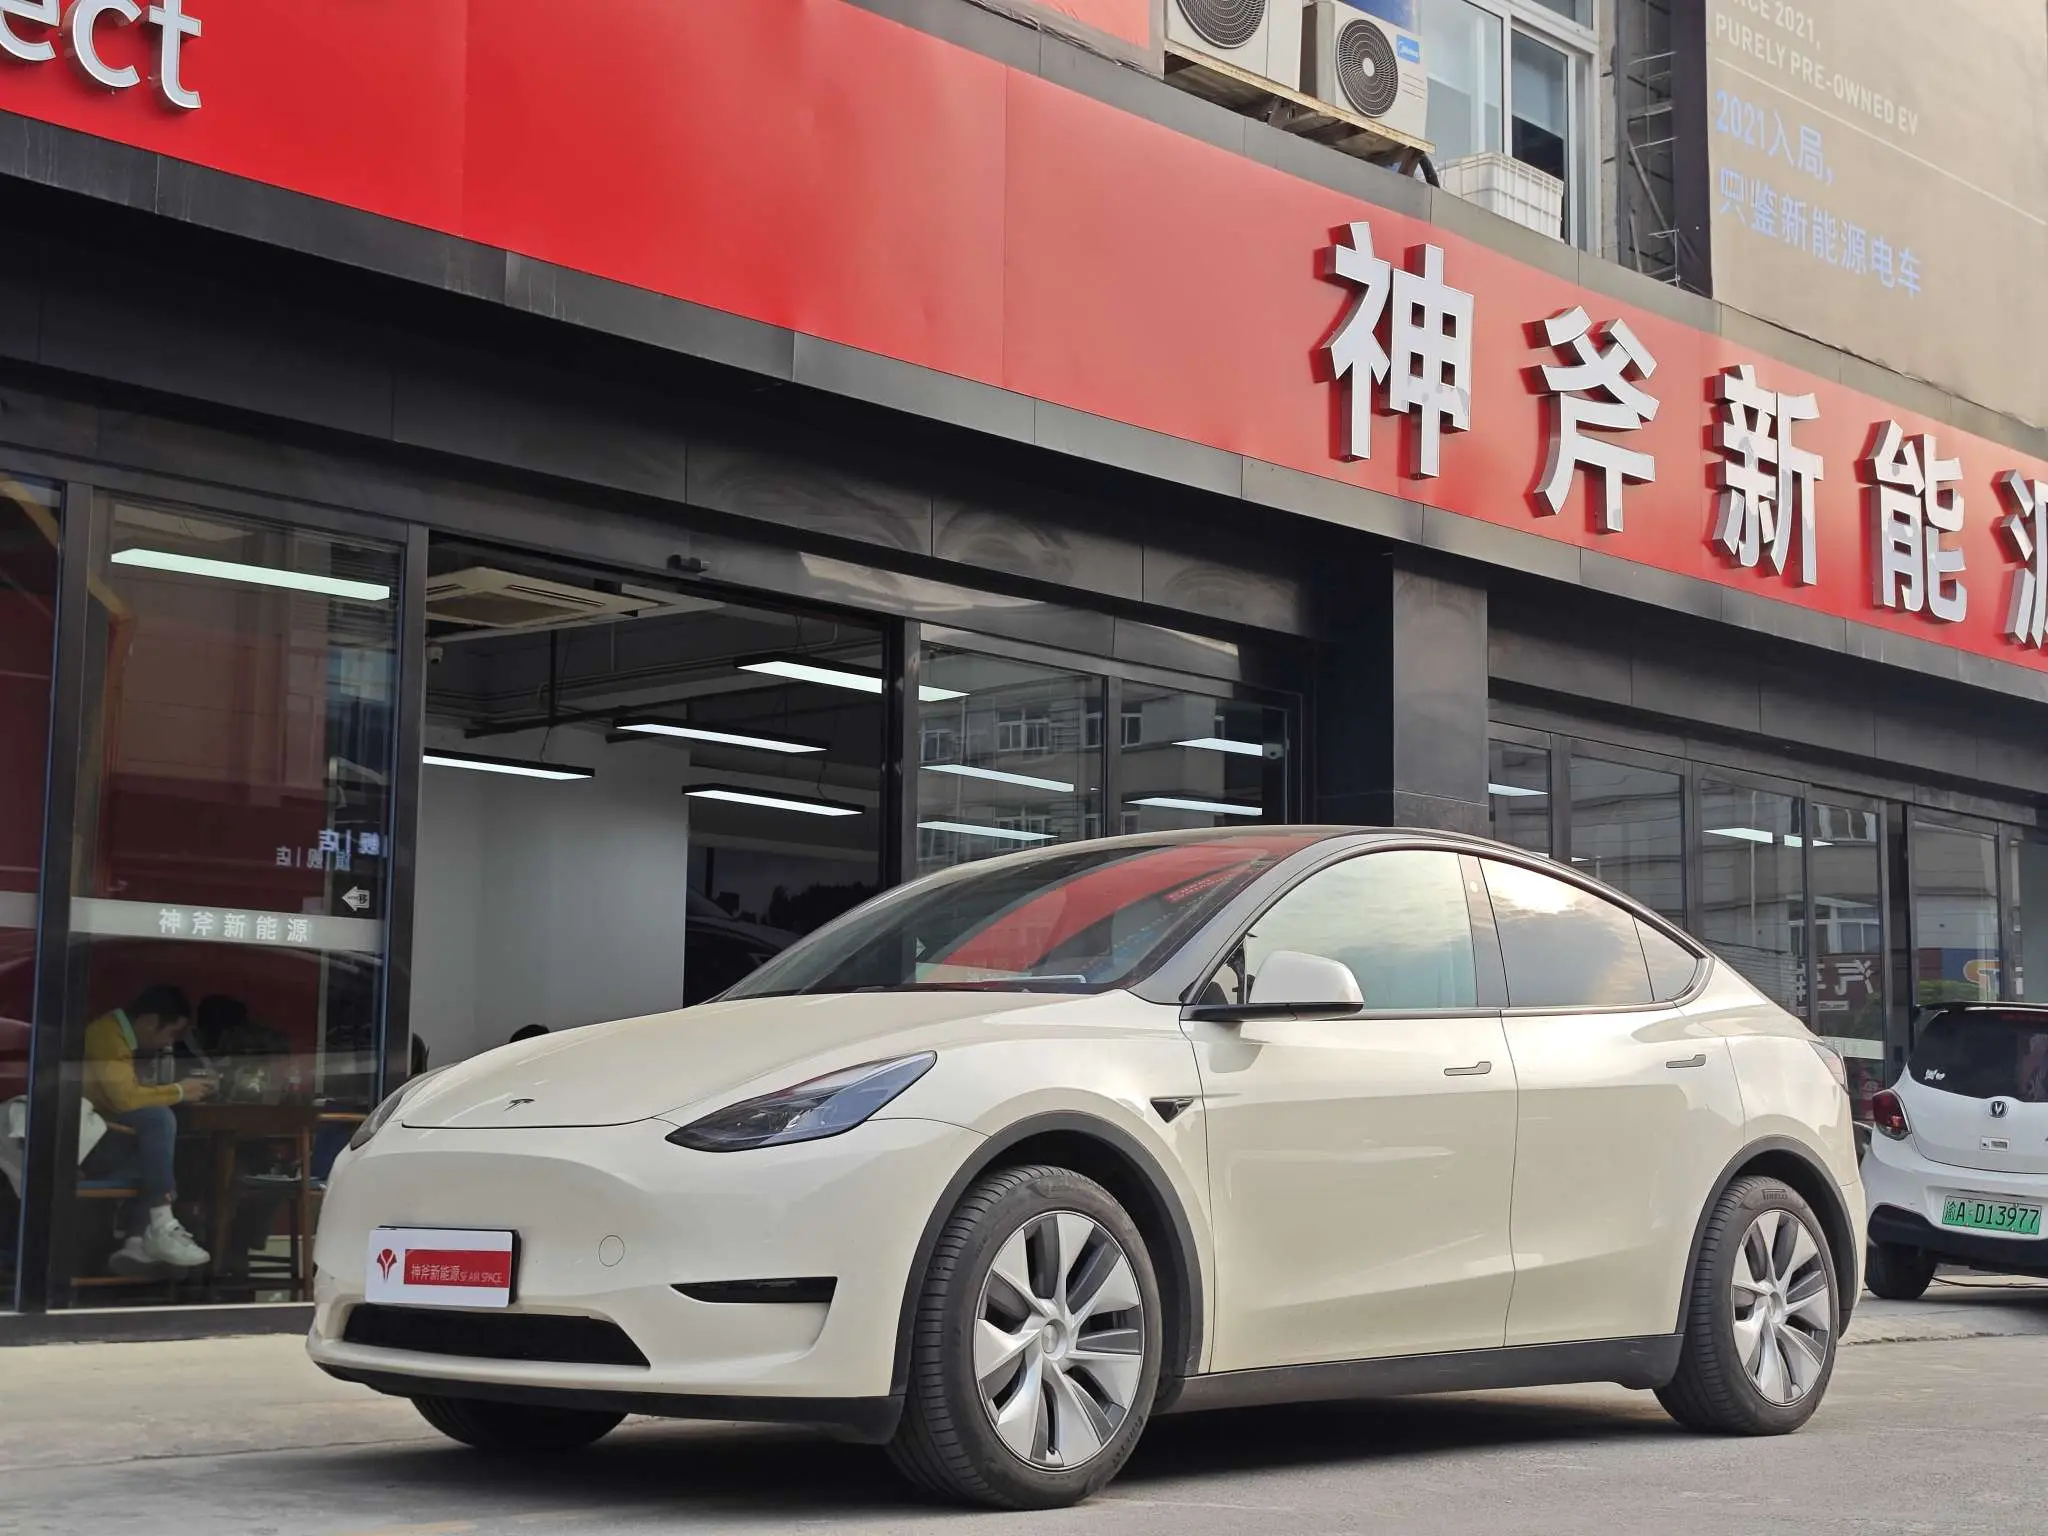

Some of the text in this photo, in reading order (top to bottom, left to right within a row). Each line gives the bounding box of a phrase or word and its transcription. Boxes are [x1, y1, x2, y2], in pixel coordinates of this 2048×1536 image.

[1775, 0, 1821, 52] 2021,
[1715, 13, 1919, 137] PURELY PRE-OWNED EV
[1718, 166, 1922, 299] 只鉴新能源电车
[158, 908, 309, 943] 神斧新能源
[1974, 1203, 2040, 1230] D13977
